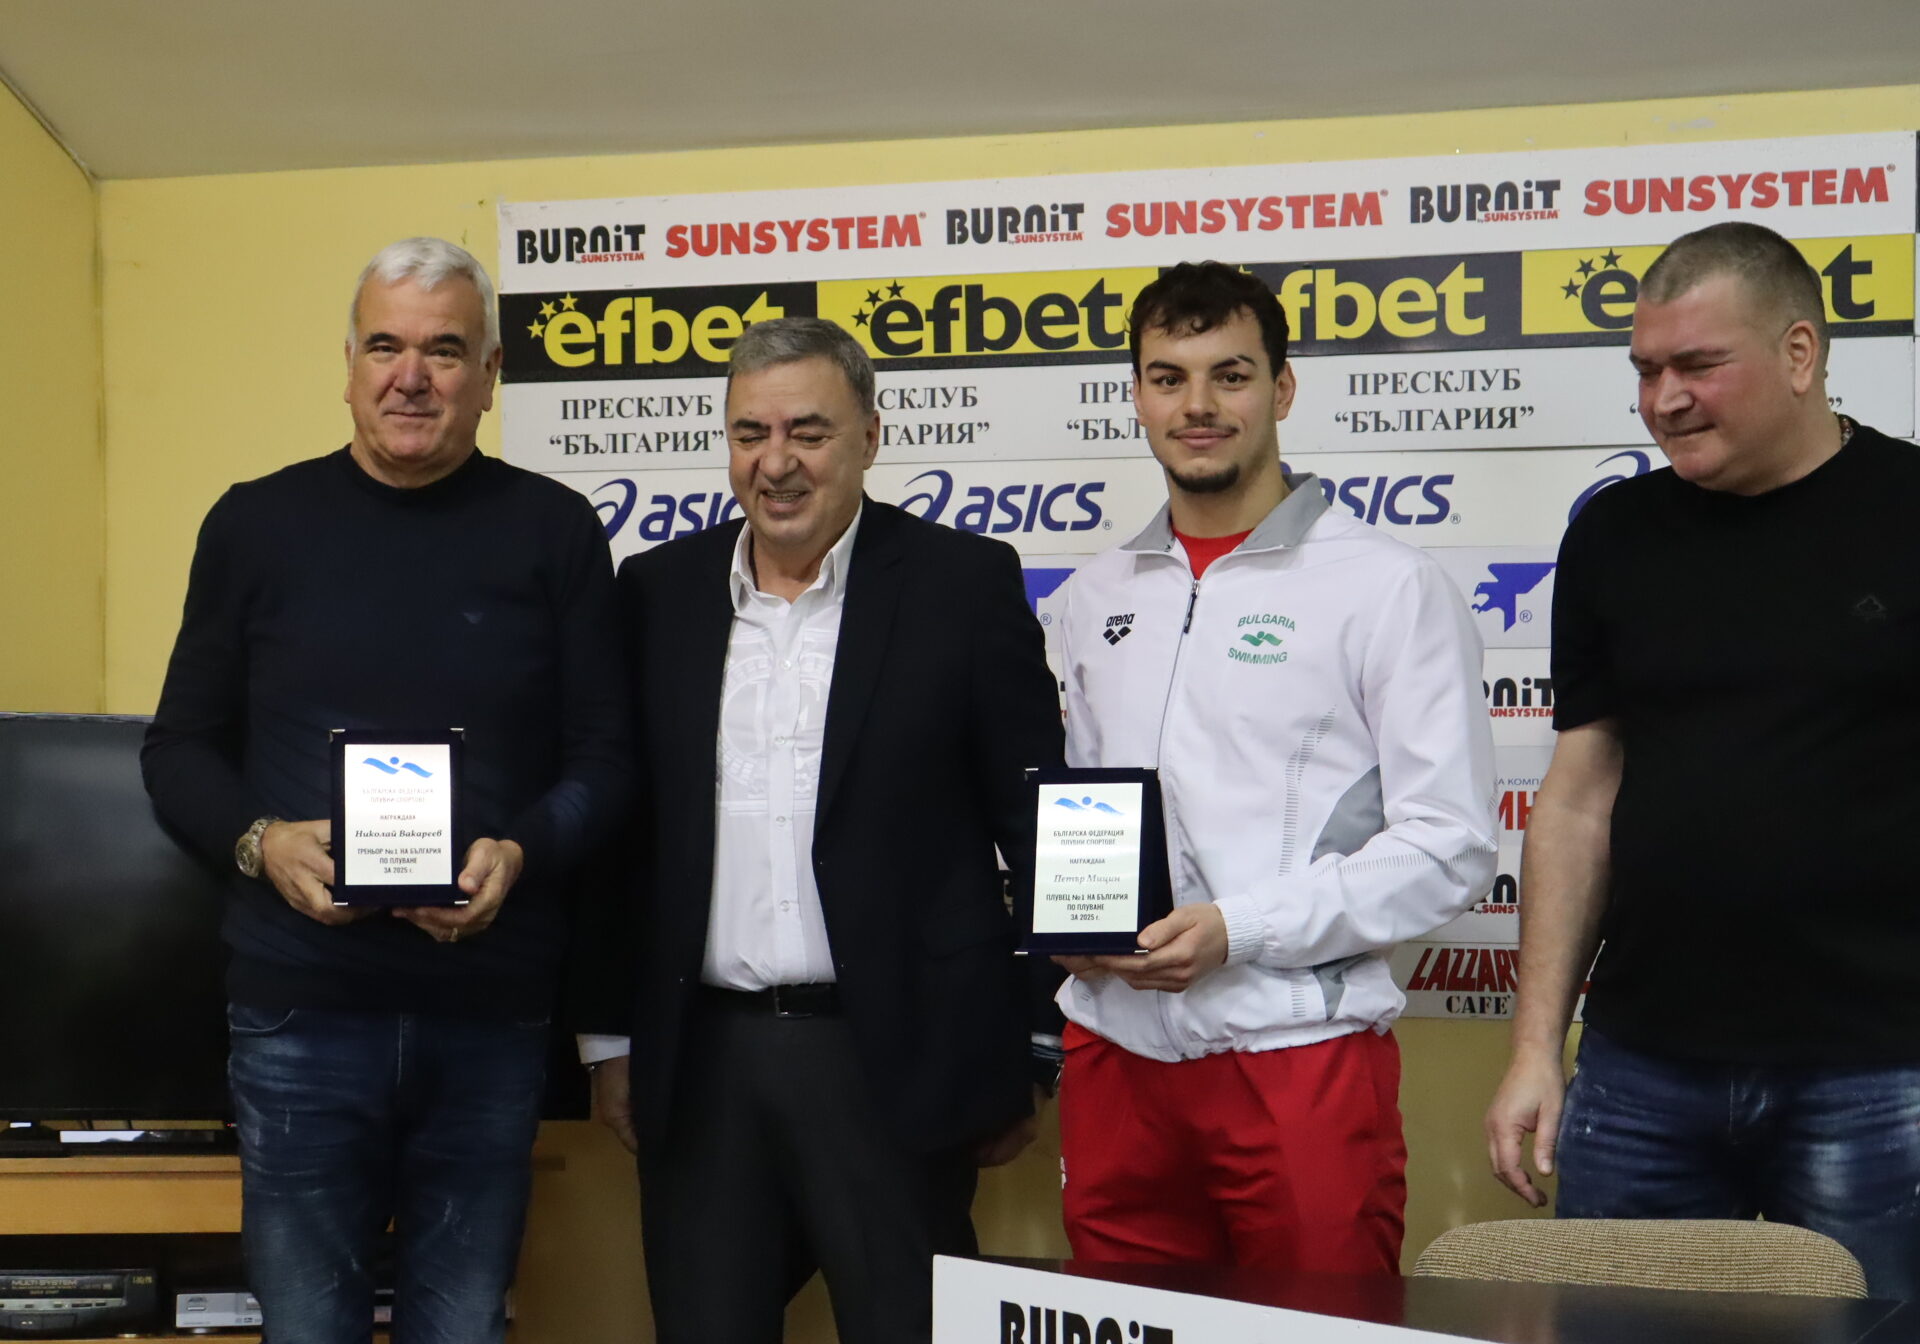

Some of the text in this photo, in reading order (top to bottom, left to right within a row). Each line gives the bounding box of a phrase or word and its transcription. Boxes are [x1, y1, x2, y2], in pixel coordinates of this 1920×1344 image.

[1483, 209, 1559, 223] SUNSYSTEM
[1014, 232, 1083, 244] SUNSYSTEM
[581, 252, 645, 264] SUNSYSTEM
[1275, 261, 1486, 342] fbet
[869, 277, 1125, 357] efbet
[1347, 368, 1522, 396] ПРЕСКЛУБ
[877, 386, 979, 411] СКЛУБ
[560, 395, 713, 420] ПРЕСКЛУБ
[881, 421, 991, 446] ГАРИЯ”
[1106, 613, 1135, 627] arena
[1237, 613, 1296, 632] BULGARIA
[1227, 647, 1288, 665] SWIMMING
[1489, 707, 1555, 718] UNSYSTEM
[1507, 777, 1540, 786] КОМП
[355, 829, 442, 839] Николай Вакареев
[1088, 829, 1124, 837] ФЕДЕРАЦИЯ
[1046, 894, 1071, 902] ПЛУВЕЦ
[1096, 893, 1128, 901] БЪЛГАРИЯ
[1070, 913, 1078, 921] ЗА
[1079, 913, 1095, 921] 2025
